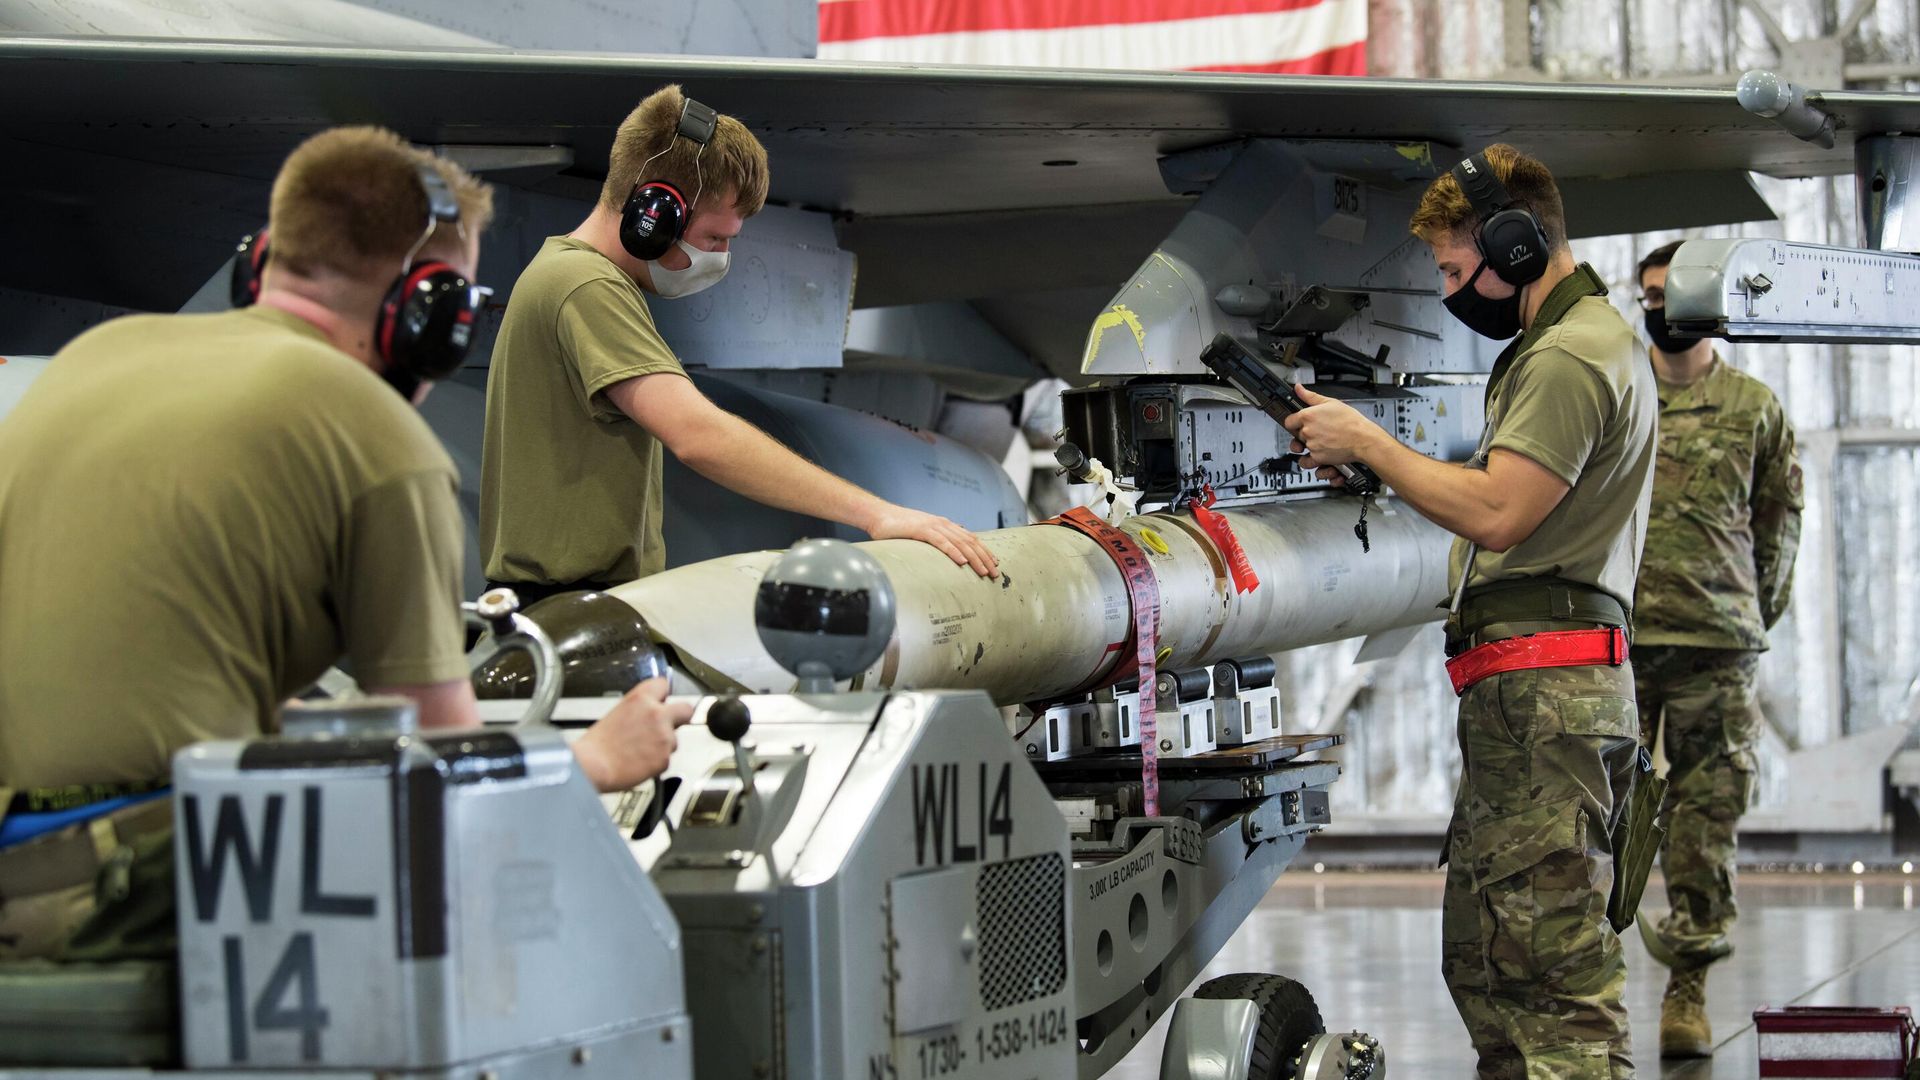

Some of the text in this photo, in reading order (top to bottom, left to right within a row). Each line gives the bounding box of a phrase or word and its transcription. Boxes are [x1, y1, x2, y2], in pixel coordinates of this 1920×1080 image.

[641, 220, 654, 231] 105
[182, 785, 377, 925] WL
[1108, 870, 1120, 890] LB
[1120, 850, 1155, 883] CAPACITY
[222, 930, 330, 1062] 14
